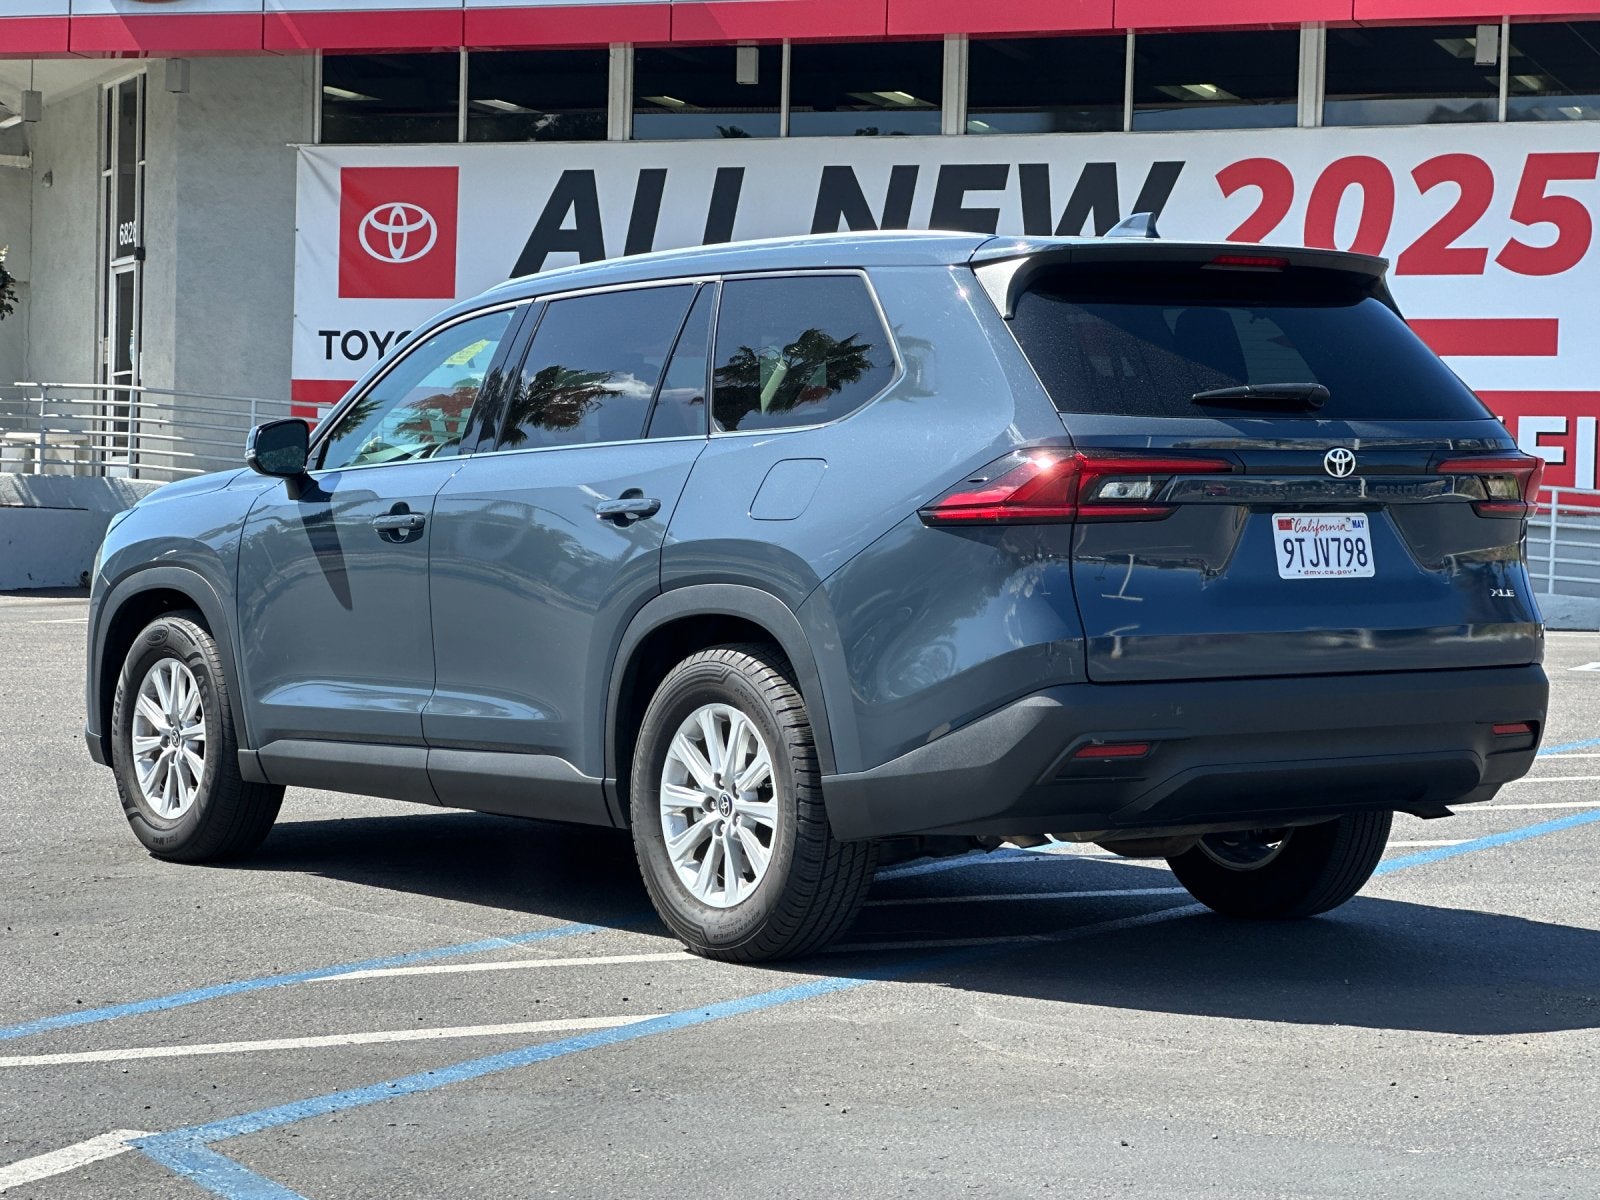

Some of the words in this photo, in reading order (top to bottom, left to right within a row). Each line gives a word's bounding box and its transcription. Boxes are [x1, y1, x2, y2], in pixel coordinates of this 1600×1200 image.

[1215, 152, 1600, 276] 2025
[1293, 517, 1352, 537] California
[1352, 519, 1365, 529] MAY
[1283, 537, 1368, 569] 9TJV798
[1490, 588, 1515, 597] XLE
